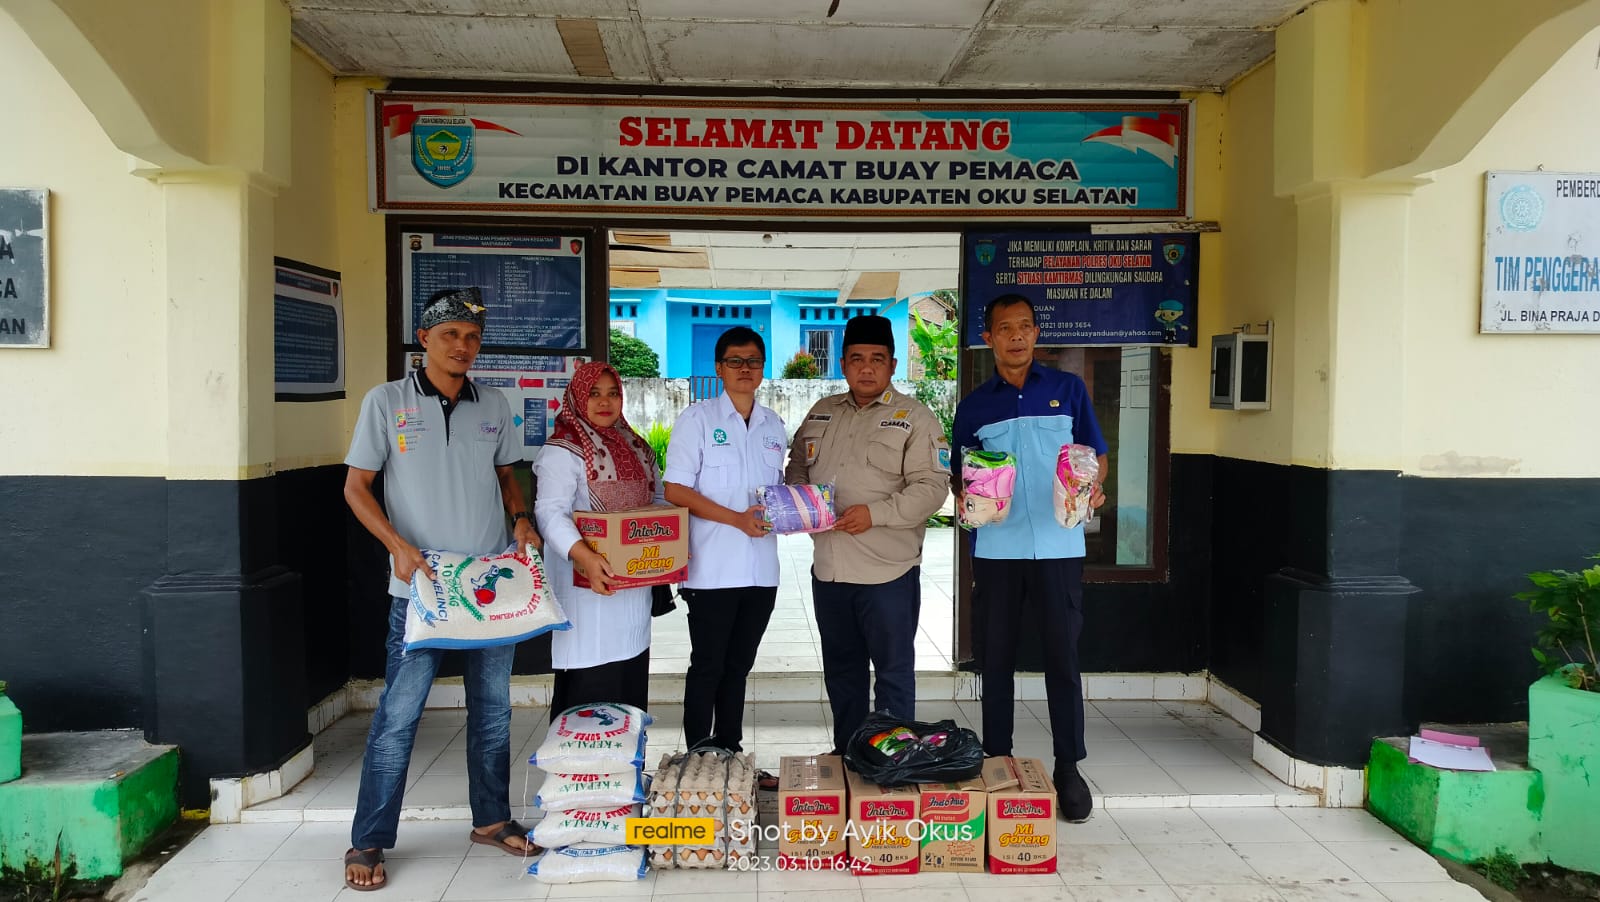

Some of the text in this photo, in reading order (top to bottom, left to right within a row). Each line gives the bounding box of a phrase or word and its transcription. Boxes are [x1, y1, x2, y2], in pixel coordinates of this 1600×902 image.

[619, 116, 1011, 151] SELAMAT DATANG
[556, 155, 1079, 182] DI KANTOR CAMAT BUAY PEMACA
[499, 182, 1137, 205] KECAMATAN BUAY PEMACA KABUPATEN OKU SELATAN
[1008, 239, 1153, 252] JIKA MEMILIKI KOMPLAIN, KRITIK DAN SARAN
[1008, 255, 1152, 268] TERHADAP PELAYANAN POLRES OKU SELATAN
[995, 271, 1163, 285] SERTA SITUASI KAMTIBMAS DILINGKUNGAN SAUDARA
[1495, 256, 1520, 292] TIM
[1046, 287, 1113, 300] MASUKAN KE DALAM
[1501, 310, 1517, 322] JL.
[1520, 310, 1547, 322] BINA
[1550, 310, 1589, 322] PRAJA
[880, 420, 911, 430] CAMAT
[641, 545, 661, 560] Mi
[626, 557, 675, 576] Goreng
[432, 579, 449, 623] KELINCI
[567, 740, 613, 750] KEPALA
[563, 780, 611, 793] KEPALA
[573, 809, 602, 822] SUPER
[563, 819, 611, 831] KEPALA
[1015, 823, 1034, 836] Mi
[999, 832, 1050, 848] Goreng
[805, 848, 819, 858] 40
[879, 853, 893, 863] 40
[1017, 852, 1031, 862] 40
